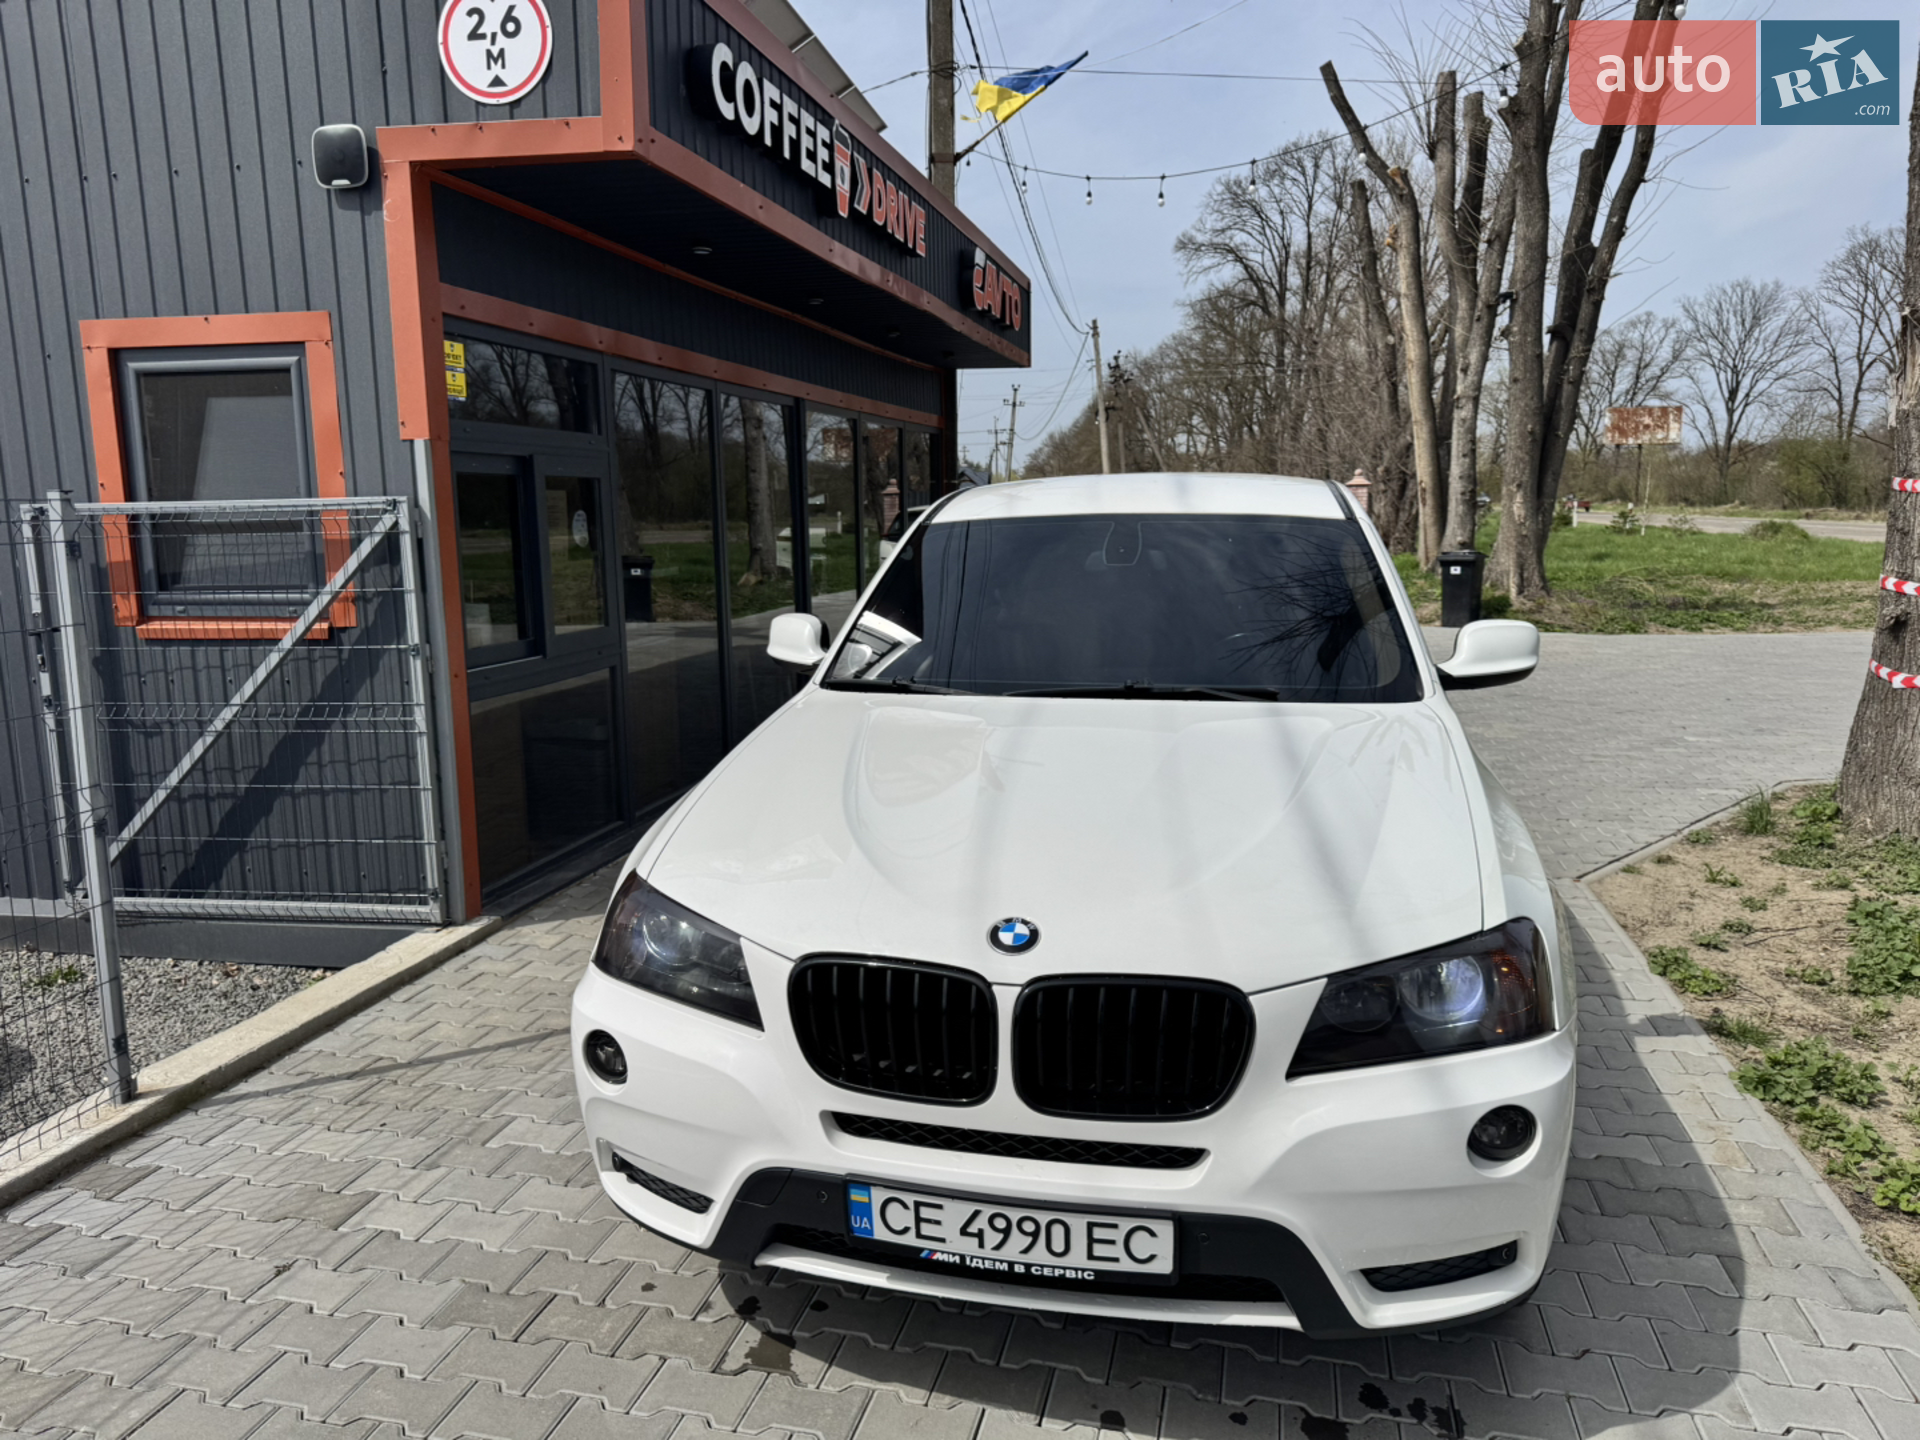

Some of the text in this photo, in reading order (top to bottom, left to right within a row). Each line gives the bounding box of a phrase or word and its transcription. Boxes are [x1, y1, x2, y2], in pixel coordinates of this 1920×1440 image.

[465, 5, 522, 46] 2,6
[711, 42, 926, 257] COFFEE DRIVE
[851, 1214, 872, 1231] UA
[879, 1195, 1158, 1265] CE 4990 EC
[965, 1255, 1008, 1272] ЇДЕМ
[1014, 1263, 1026, 1273] В
[1031, 1266, 1096, 1281] СЕРВІС
